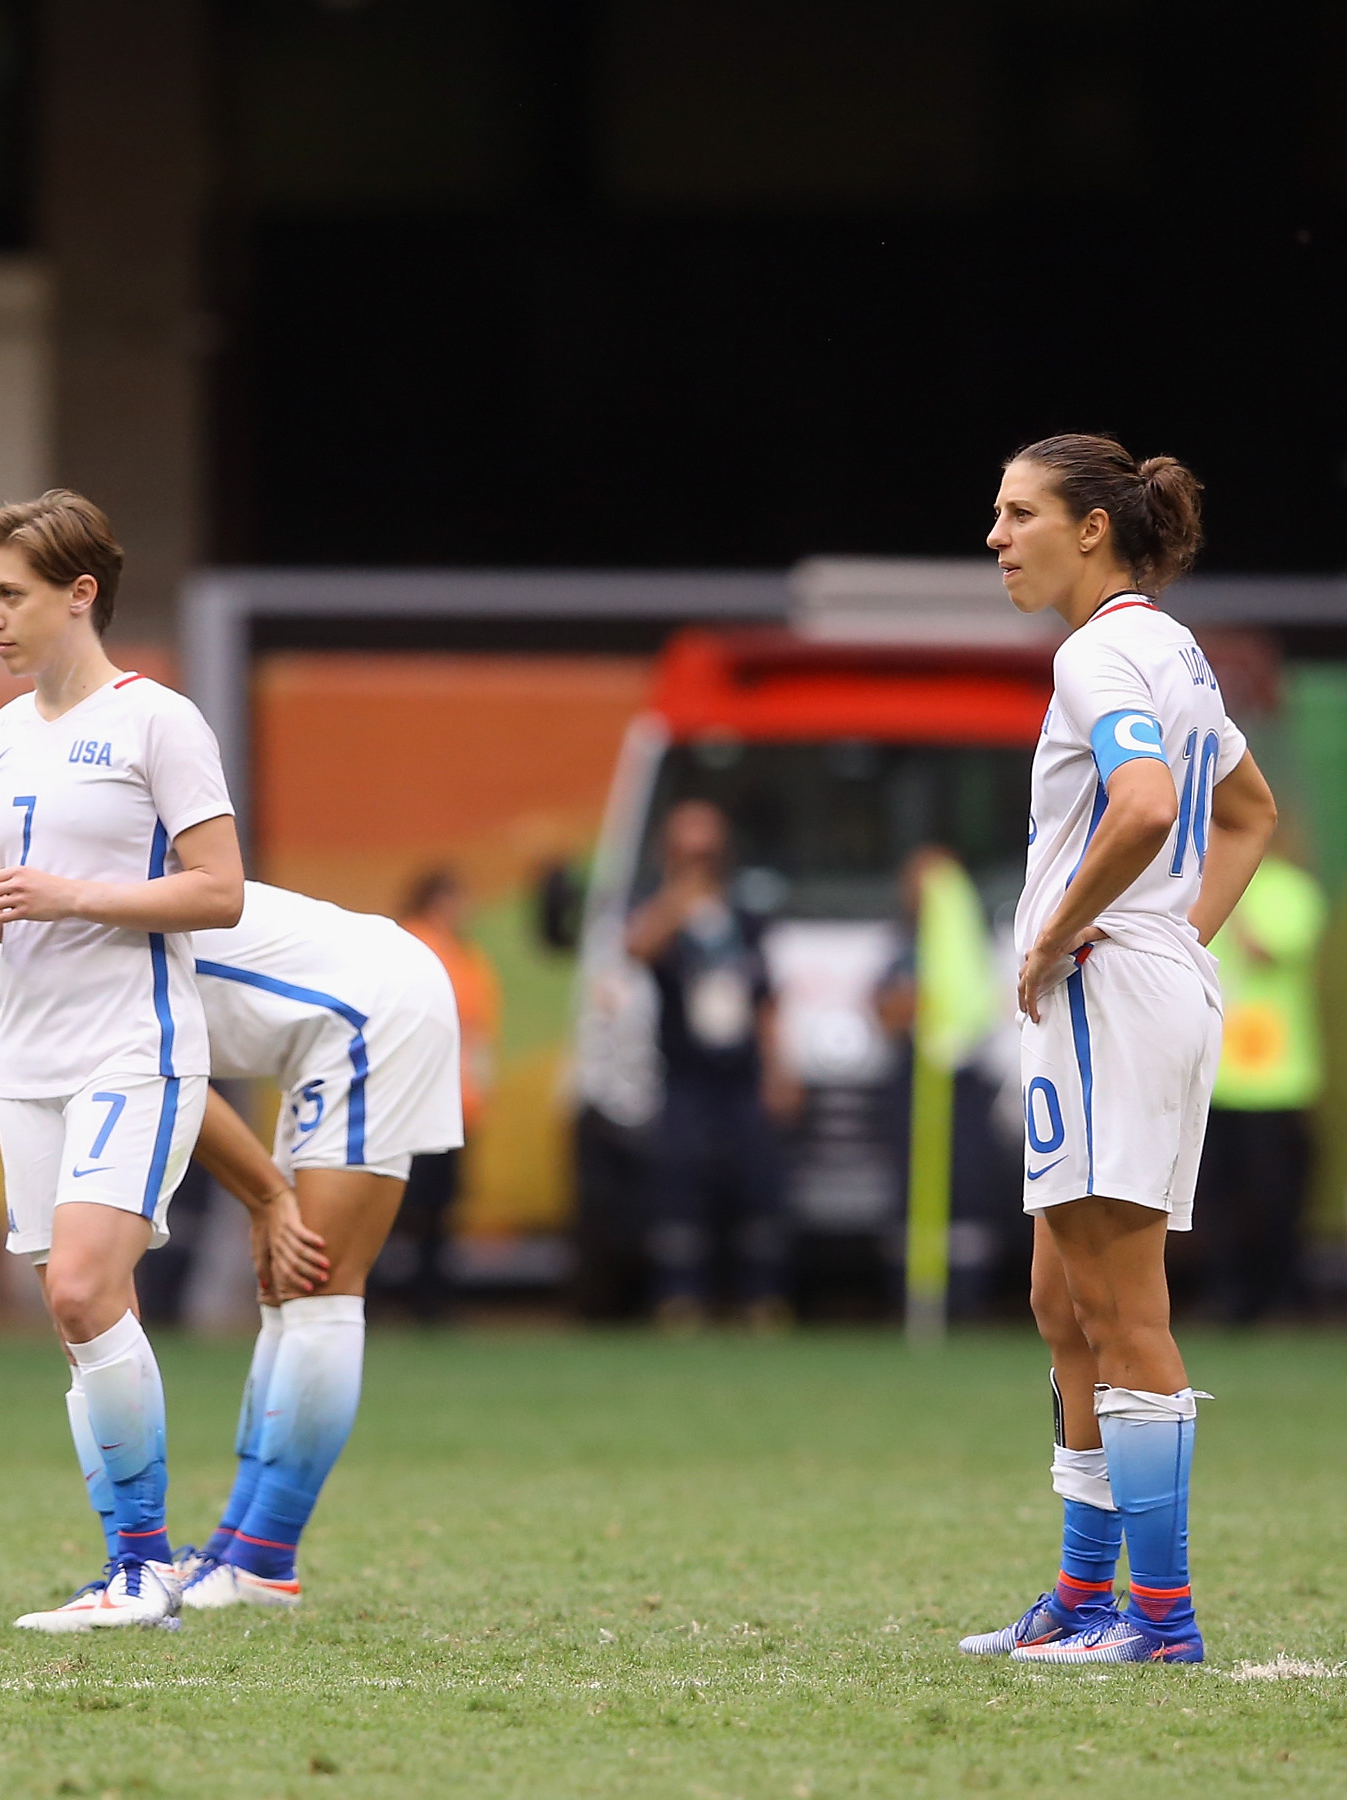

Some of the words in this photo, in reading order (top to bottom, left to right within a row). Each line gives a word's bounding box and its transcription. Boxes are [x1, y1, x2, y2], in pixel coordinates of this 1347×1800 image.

[69, 740, 112, 767] USA
[1113, 714, 1163, 755] C
[13, 795, 37, 866] 7
[1169, 727, 1219, 878] 10
[89, 1091, 127, 1159] 7
[1023, 1076, 1066, 1154] 0
